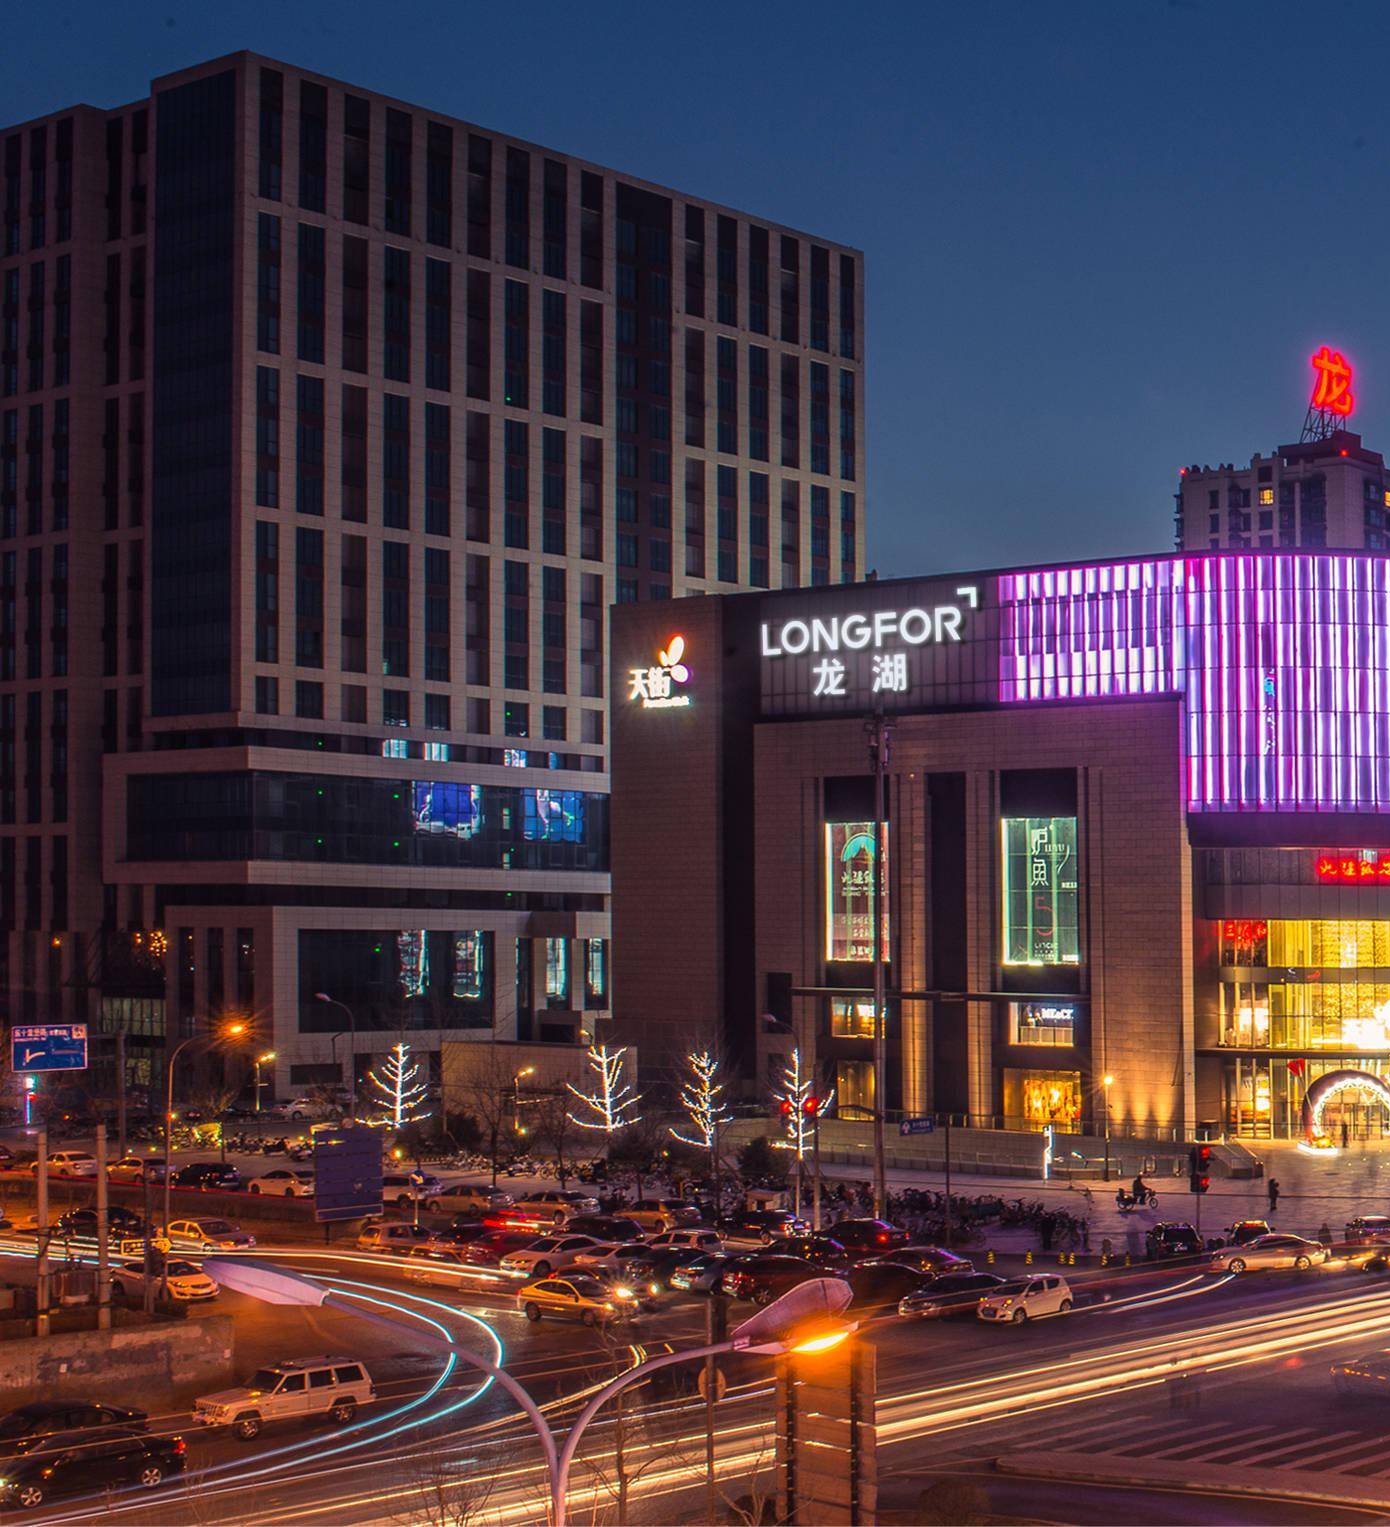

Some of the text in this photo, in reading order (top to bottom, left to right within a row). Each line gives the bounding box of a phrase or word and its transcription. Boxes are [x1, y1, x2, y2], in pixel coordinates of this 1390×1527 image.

[1312, 346, 1353, 416] 龙
[761, 605, 962, 656] LONGFOR
[812, 653, 907, 697] 龙湖
